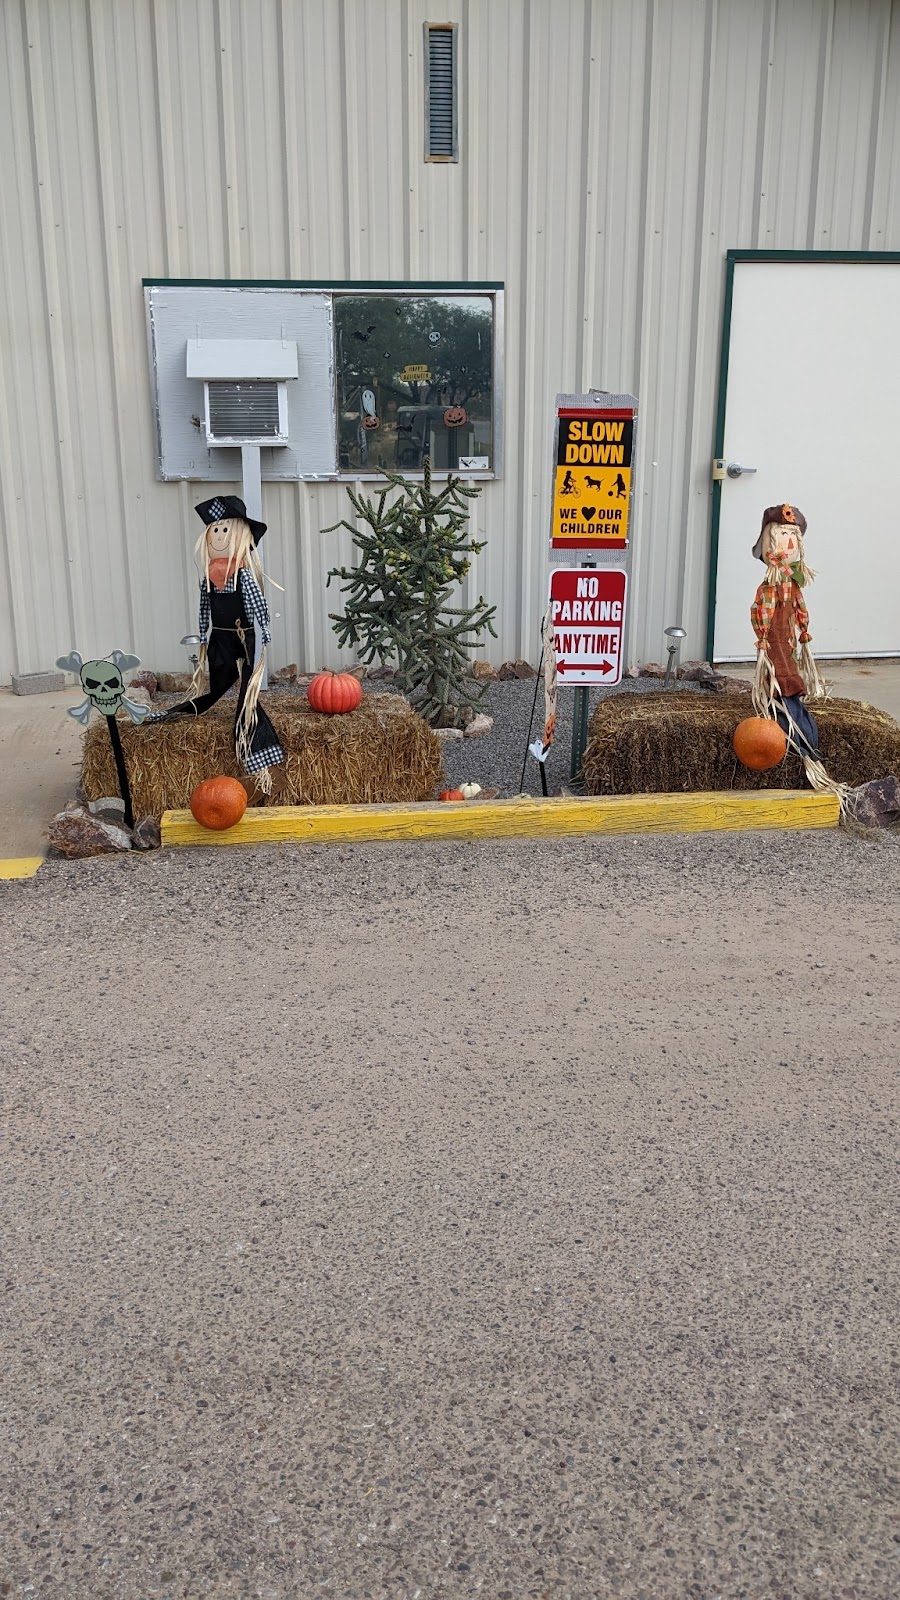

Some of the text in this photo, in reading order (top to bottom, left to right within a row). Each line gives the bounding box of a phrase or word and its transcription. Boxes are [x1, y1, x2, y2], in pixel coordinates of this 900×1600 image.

[568, 421, 625, 442] SLOW
[565, 443, 625, 464] DOWN
[559, 508, 622, 520] WE OUR
[560, 523, 620, 534] CHILDREN
[576, 577, 599, 599] NO
[552, 600, 622, 621] PARKING
[554, 633, 618, 654] ANYTIME
